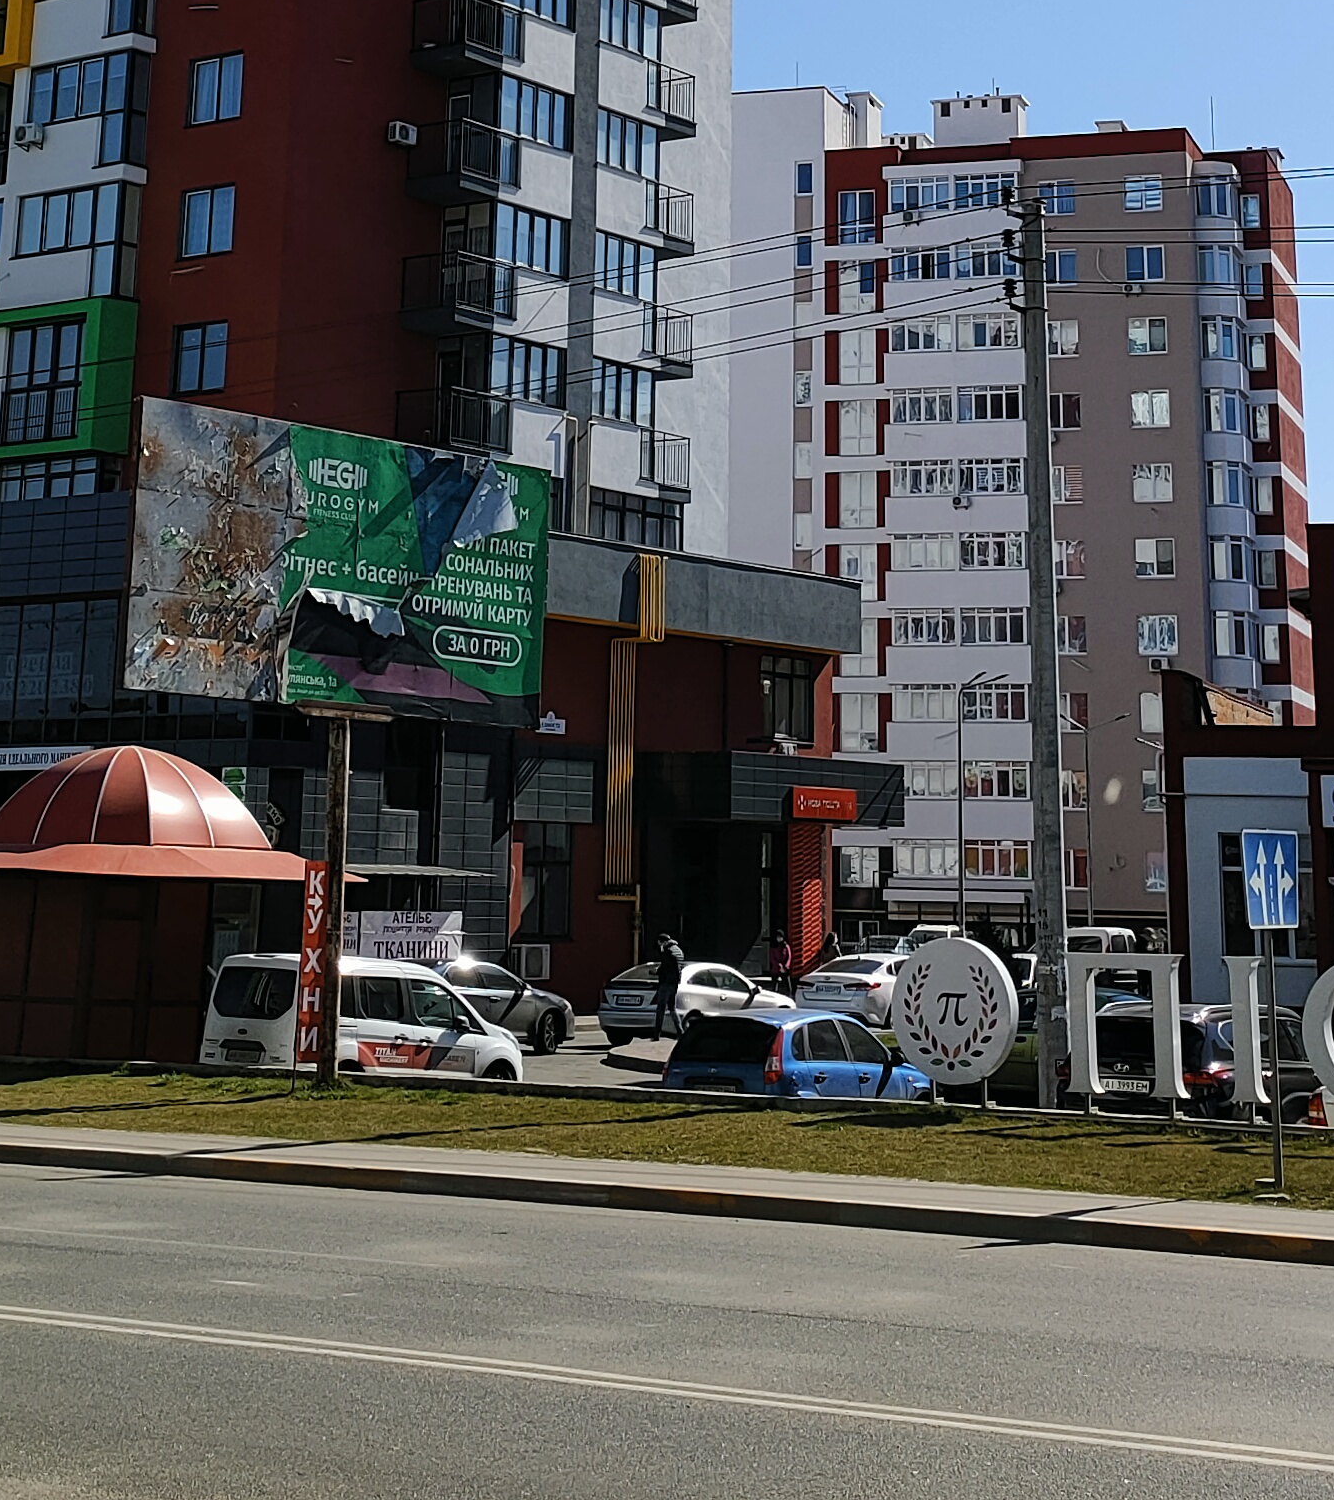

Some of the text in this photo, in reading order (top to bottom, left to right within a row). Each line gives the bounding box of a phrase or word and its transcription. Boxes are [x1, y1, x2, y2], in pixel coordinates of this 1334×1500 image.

[313, 508, 340, 519] FITNESS
[490, 538, 535, 559] ПАКЕТ
[445, 554, 533, 582] СОНАЛЬНИХ
[516, 586, 532, 604] ТА
[412, 594, 532, 626] ОТРИМУЙ КАРТУ
[448, 634, 466, 653] ЗА
[484, 639, 511, 658] ГРН
[392, 912, 432, 924] АТЕЛЬЄ
[374, 941, 449, 959] ТКАНИНИ
[375, 1047, 397, 1056] TITAN
